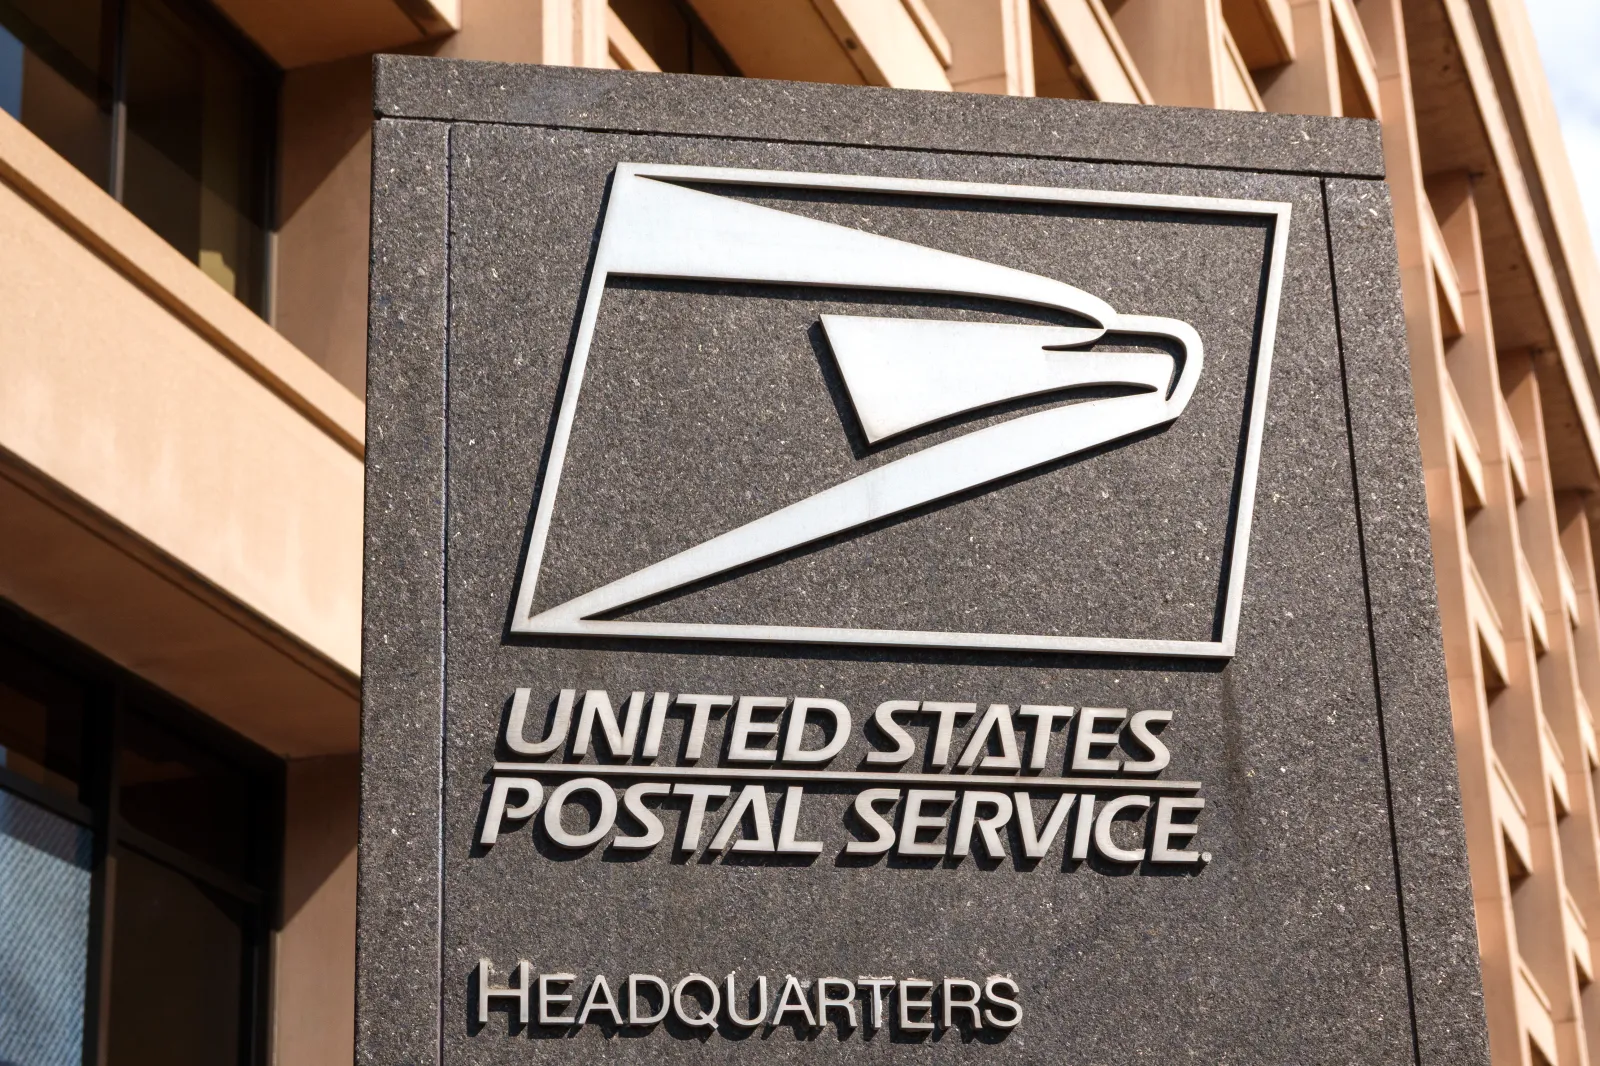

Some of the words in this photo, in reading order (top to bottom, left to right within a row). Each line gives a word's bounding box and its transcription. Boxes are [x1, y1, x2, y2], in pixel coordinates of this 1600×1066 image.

[505, 687, 852, 765] UNITED
[866, 700, 1173, 774] STATES
[480, 776, 824, 855] POSTAL
[478, 958, 1023, 1031] HEADQUARTERS
